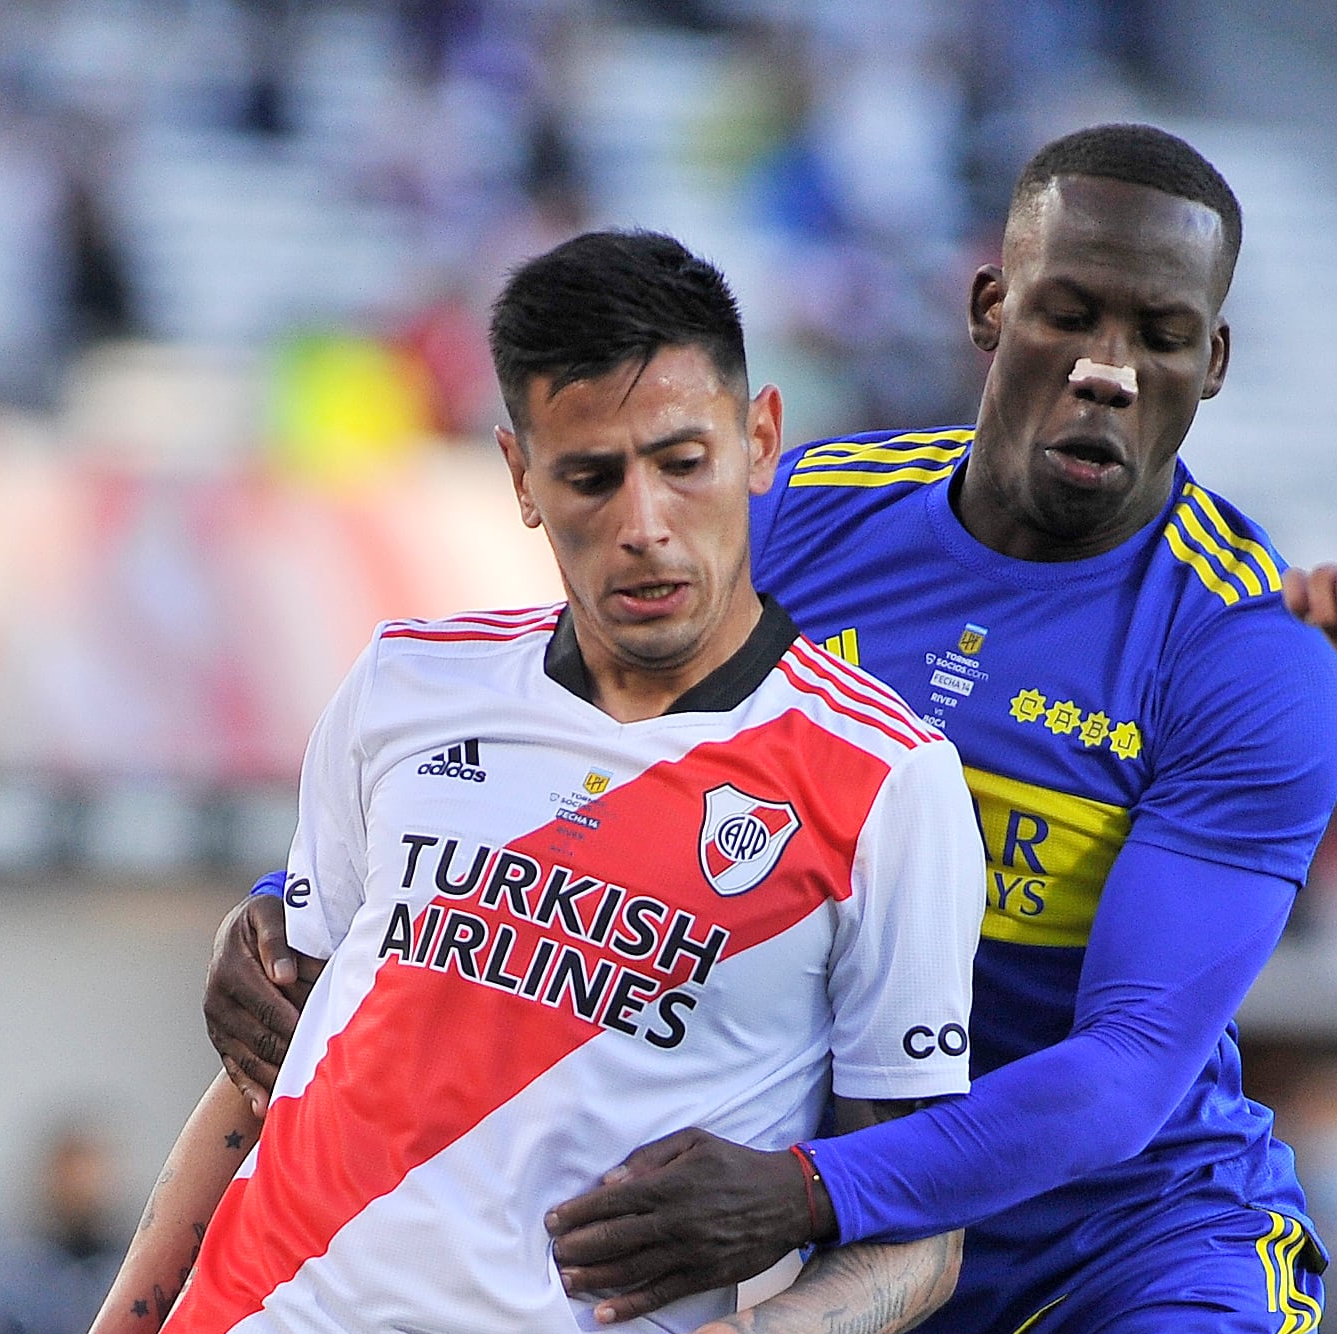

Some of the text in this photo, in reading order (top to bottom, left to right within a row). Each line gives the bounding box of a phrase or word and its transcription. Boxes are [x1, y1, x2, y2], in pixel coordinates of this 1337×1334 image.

[945, 651, 979, 669] TORNEO
[932, 672, 970, 692] FECHA 14
[930, 692, 958, 708] RIVER
[922, 714, 946, 729] BOCA
[417, 760, 487, 783] adidas
[556, 808, 587, 826] FECHA
[286, 872, 311, 908] e
[987, 871, 1047, 917] YS
[401, 833, 730, 985] TURKISH
[377, 902, 698, 1049] AIRLINES
